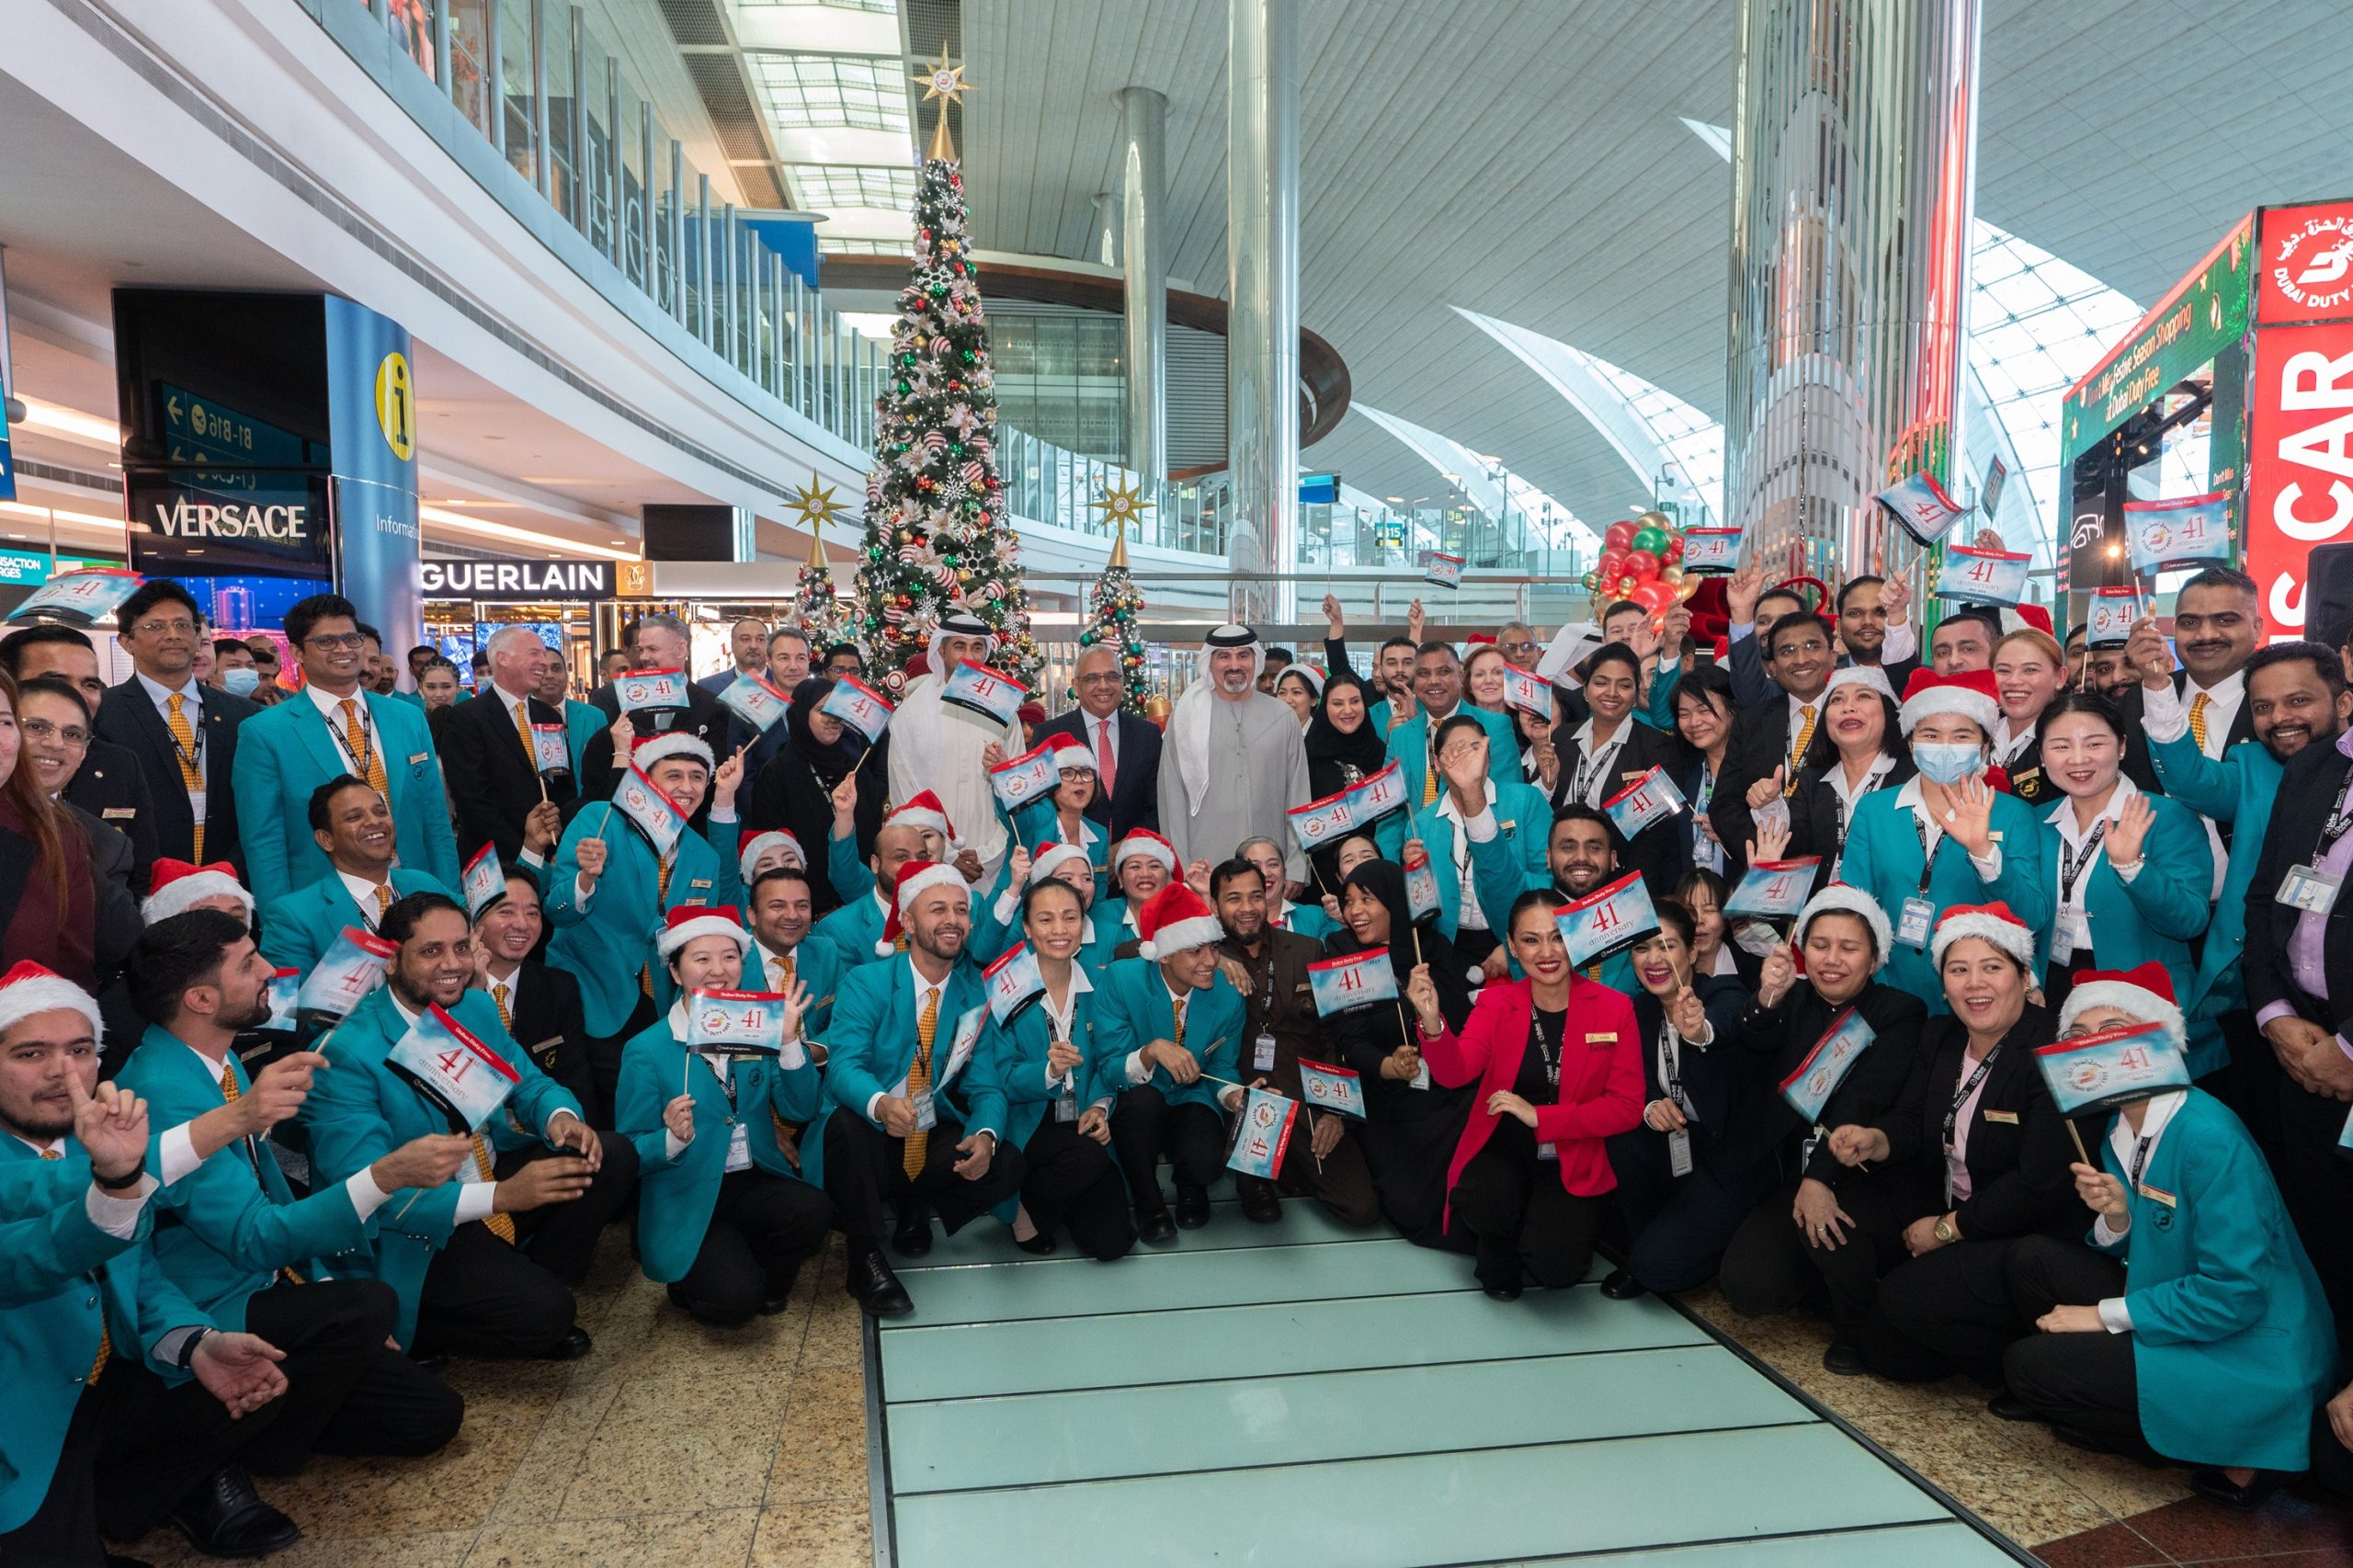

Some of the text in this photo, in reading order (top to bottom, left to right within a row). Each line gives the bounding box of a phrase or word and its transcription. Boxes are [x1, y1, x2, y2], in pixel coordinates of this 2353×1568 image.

[2274, 267, 2351, 309] DUBAI DUTY
[2132, 335, 2155, 369] Season
[2156, 302, 2192, 350] Shopping
[2112, 383, 2129, 418] Dubai
[2128, 377, 2144, 404] Duty
[2144, 366, 2160, 393] Free
[2273, 350, 2353, 541] CAR
[156, 505, 307, 538] VERSACE
[1915, 502, 1947, 524] 41
[1709, 540, 1724, 554] 41
[419, 562, 604, 591] GUERLAIN
[72, 580, 102, 597] 41
[2117, 604, 2133, 623] 41
[655, 680, 672, 694] 41
[1519, 679, 1534, 699] 41
[746, 690, 769, 710] 41
[851, 698, 874, 718] 41
[1032, 762, 1047, 779] 41
[1369, 781, 1389, 803] 41
[653, 810, 669, 828] 41
[1331, 806, 1348, 823] 41
[1588, 919, 1634, 947] anniversary
[999, 968, 1017, 994] 41
[740, 1009, 764, 1028] 41
[1834, 1035, 1852, 1058] 41
[418, 1058, 469, 1100] anniversary
[1333, 1082, 1347, 1098] 41
[1250, 1137, 1268, 1158] 41
